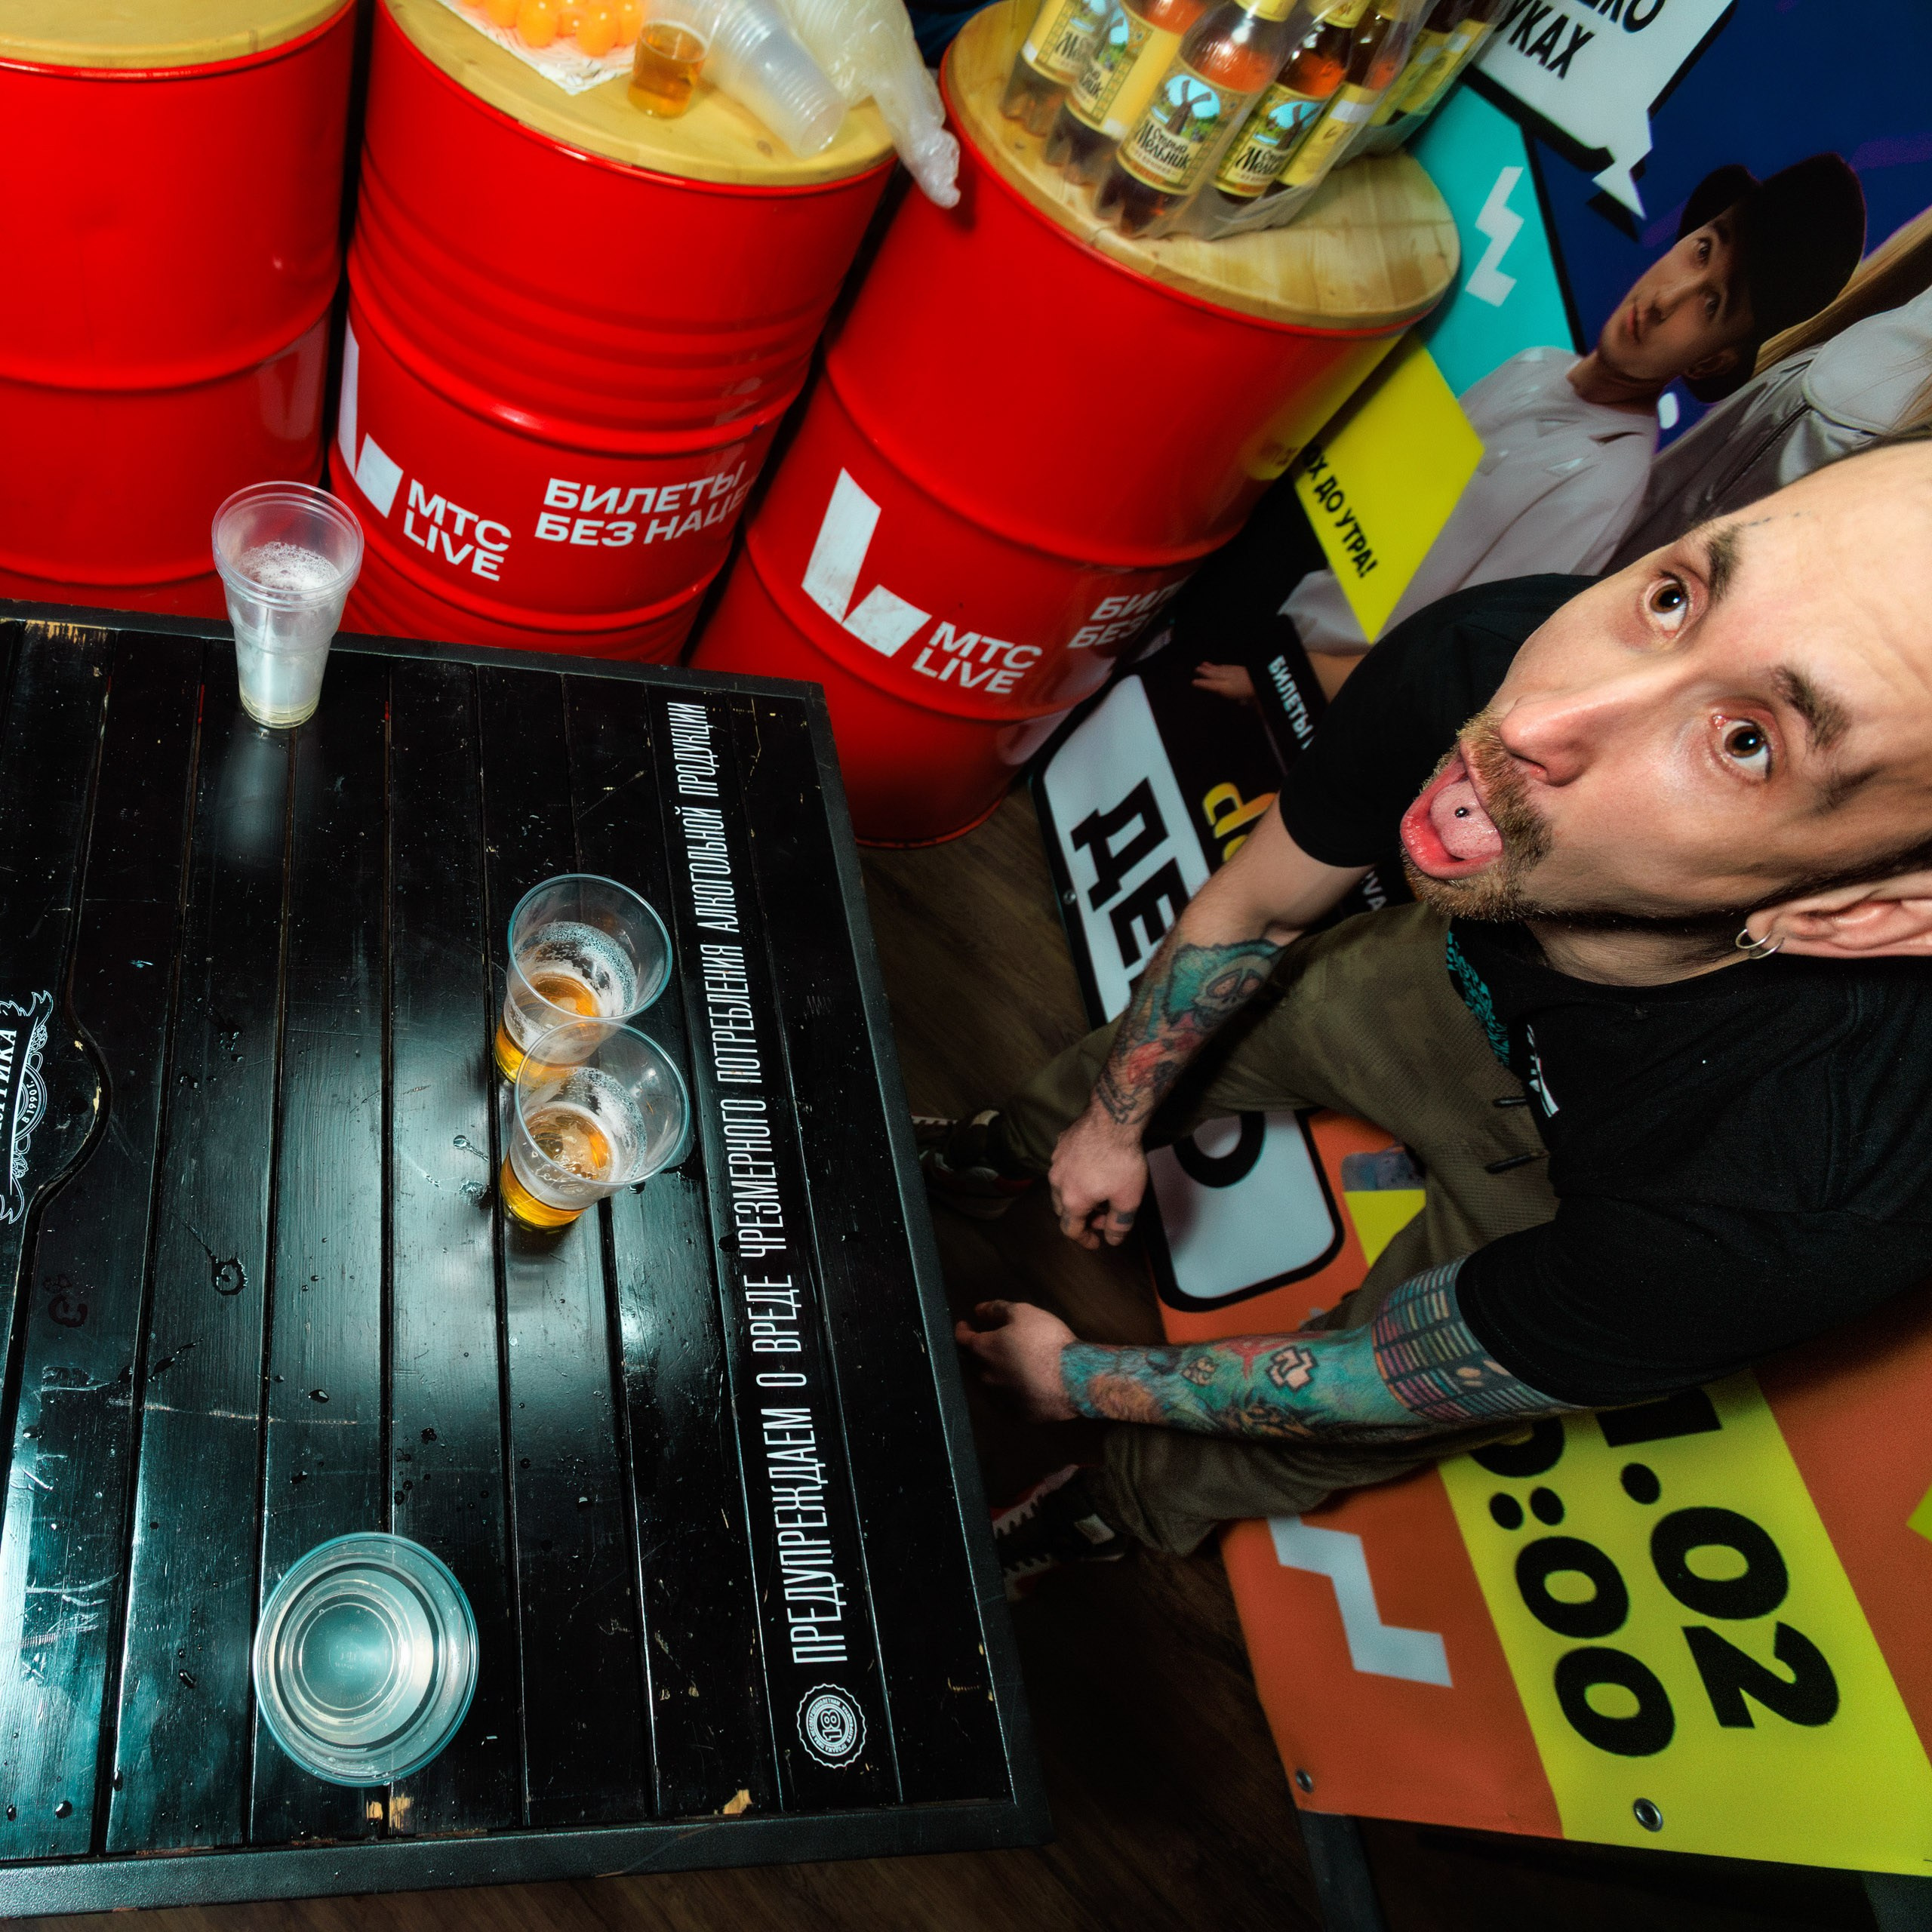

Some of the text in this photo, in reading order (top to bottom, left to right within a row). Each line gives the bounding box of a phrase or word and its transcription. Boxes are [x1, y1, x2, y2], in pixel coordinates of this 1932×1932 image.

[408, 478, 512, 552] МТС
[543, 460, 747, 515] БИЛЕТЫ
[403, 508, 504, 582] LIVE
[534, 511, 638, 547] БЕЗ
[1313, 475, 1345, 513] ДО
[1334, 507, 1379, 579] УТРА!
[912, 647, 1025, 694] LIVE
[928, 620, 1043, 670] МТС
[1267, 654, 1314, 740] БИЛЕТЫ
[28, 1089, 38, 1115] 1990
[667, 701, 848, 1664] ПРЕДУПРЕЖДАЕМ О ВРЕДЕ ЧРЕЗМЕРНОГО ПОТРЕБЛЕНИЯ АЛКОГОЛЬНОЙ ПРОДУКЦИИ
[820, 1709, 842, 1741] 18
